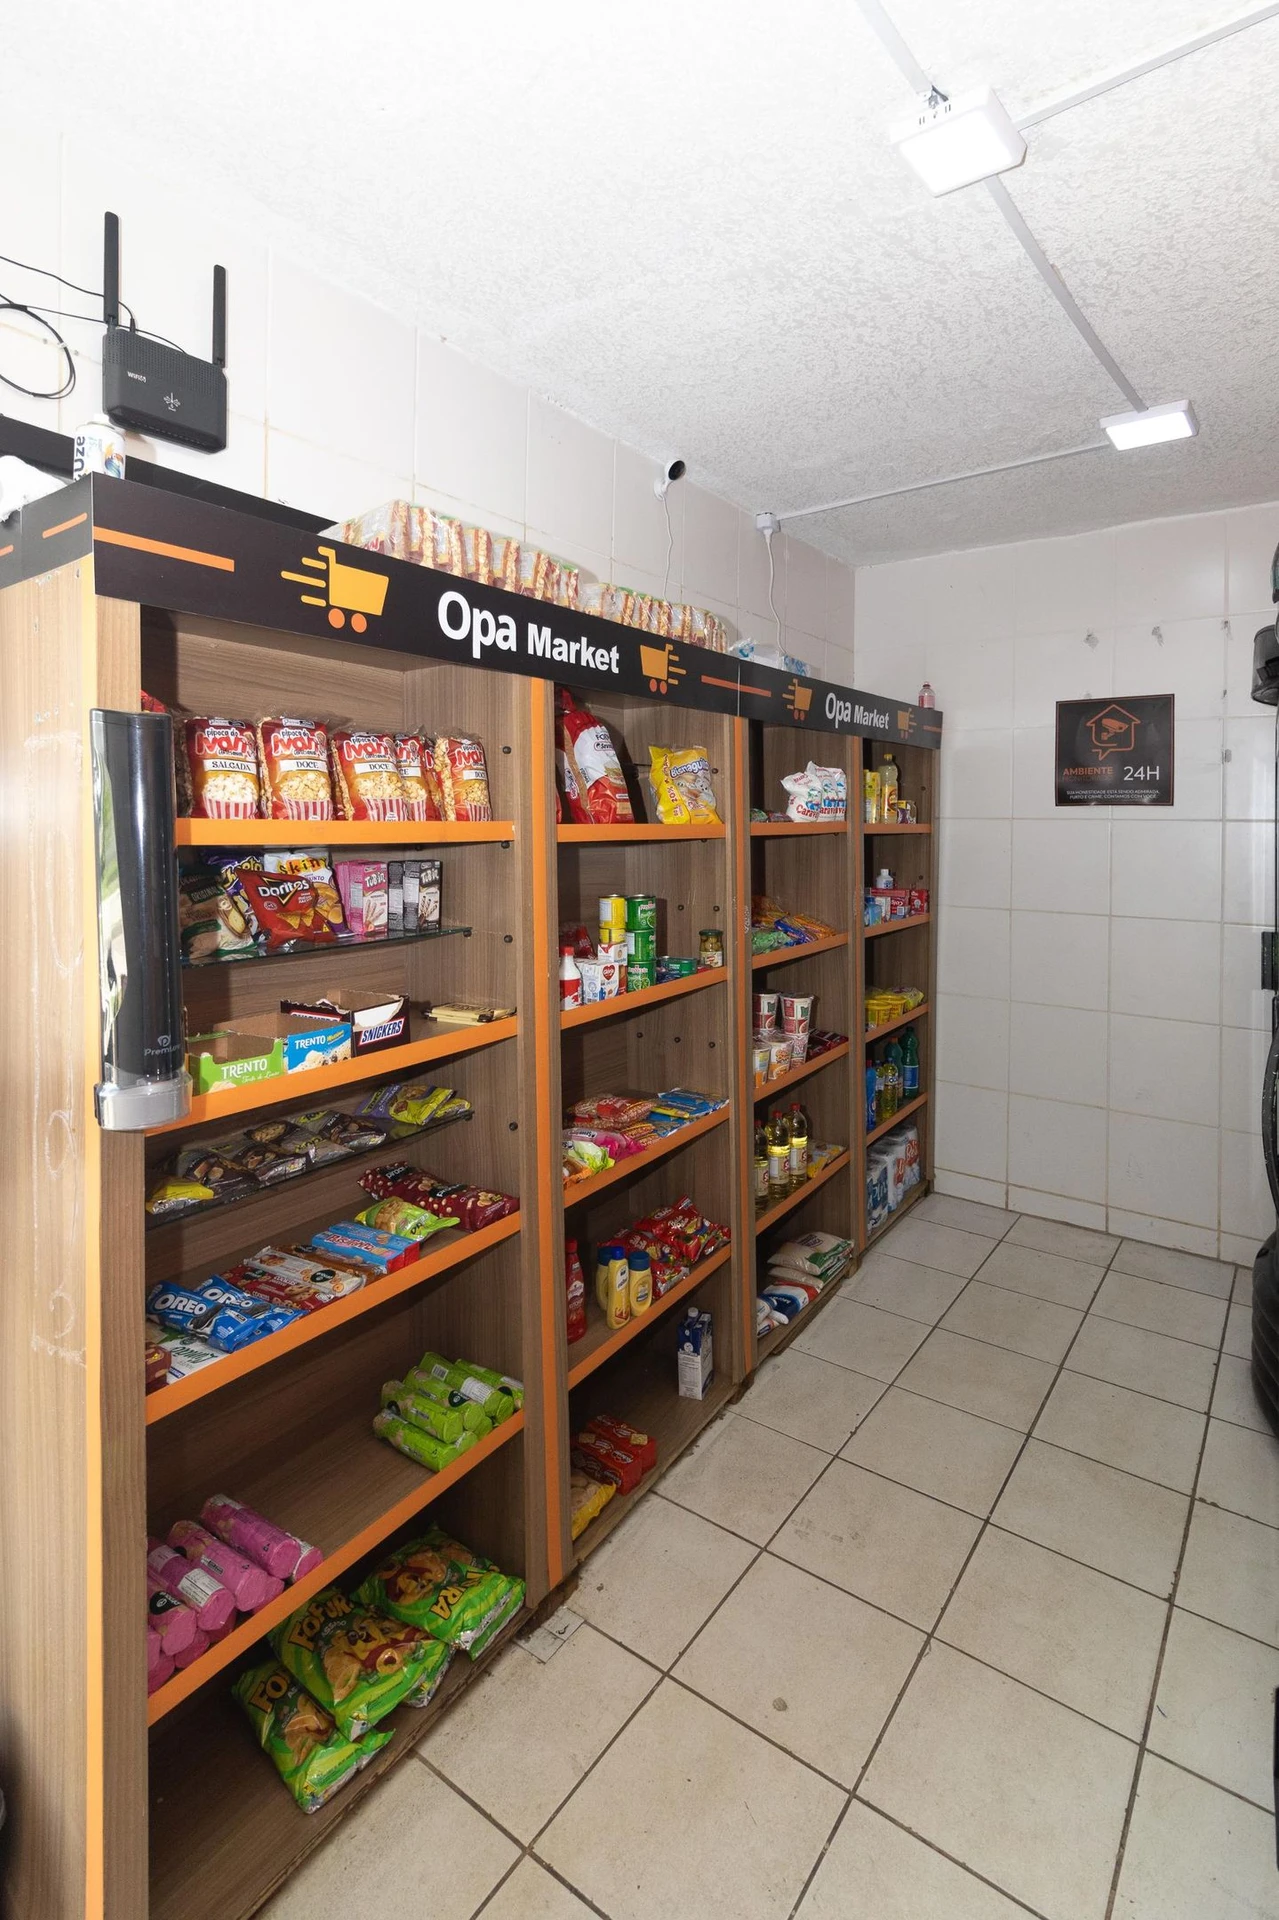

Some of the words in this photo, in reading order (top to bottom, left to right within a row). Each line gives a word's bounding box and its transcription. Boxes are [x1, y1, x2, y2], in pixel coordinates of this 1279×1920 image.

[437, 590, 518, 659] Opa
[527, 622, 620, 674] Market
[825, 692, 851, 729] Opa
[854, 704, 890, 730] Market
[196, 732, 248, 755] Ivan
[272, 733, 318, 756] Ivan
[344, 740, 390, 760] Ivan
[296, 761, 319, 769] DOCE
[1063, 766, 1114, 776] AMBIENTE
[1123, 766, 1160, 781] 24H
[258, 879, 310, 897] Doritos
[294, 1034, 326, 1050] TRENTO
[362, 1020, 404, 1044] SNICKERS
[221, 1058, 268, 1080] TRENTO
[154, 1292, 207, 1315] OREO
[202, 1287, 253, 1308] OREO
